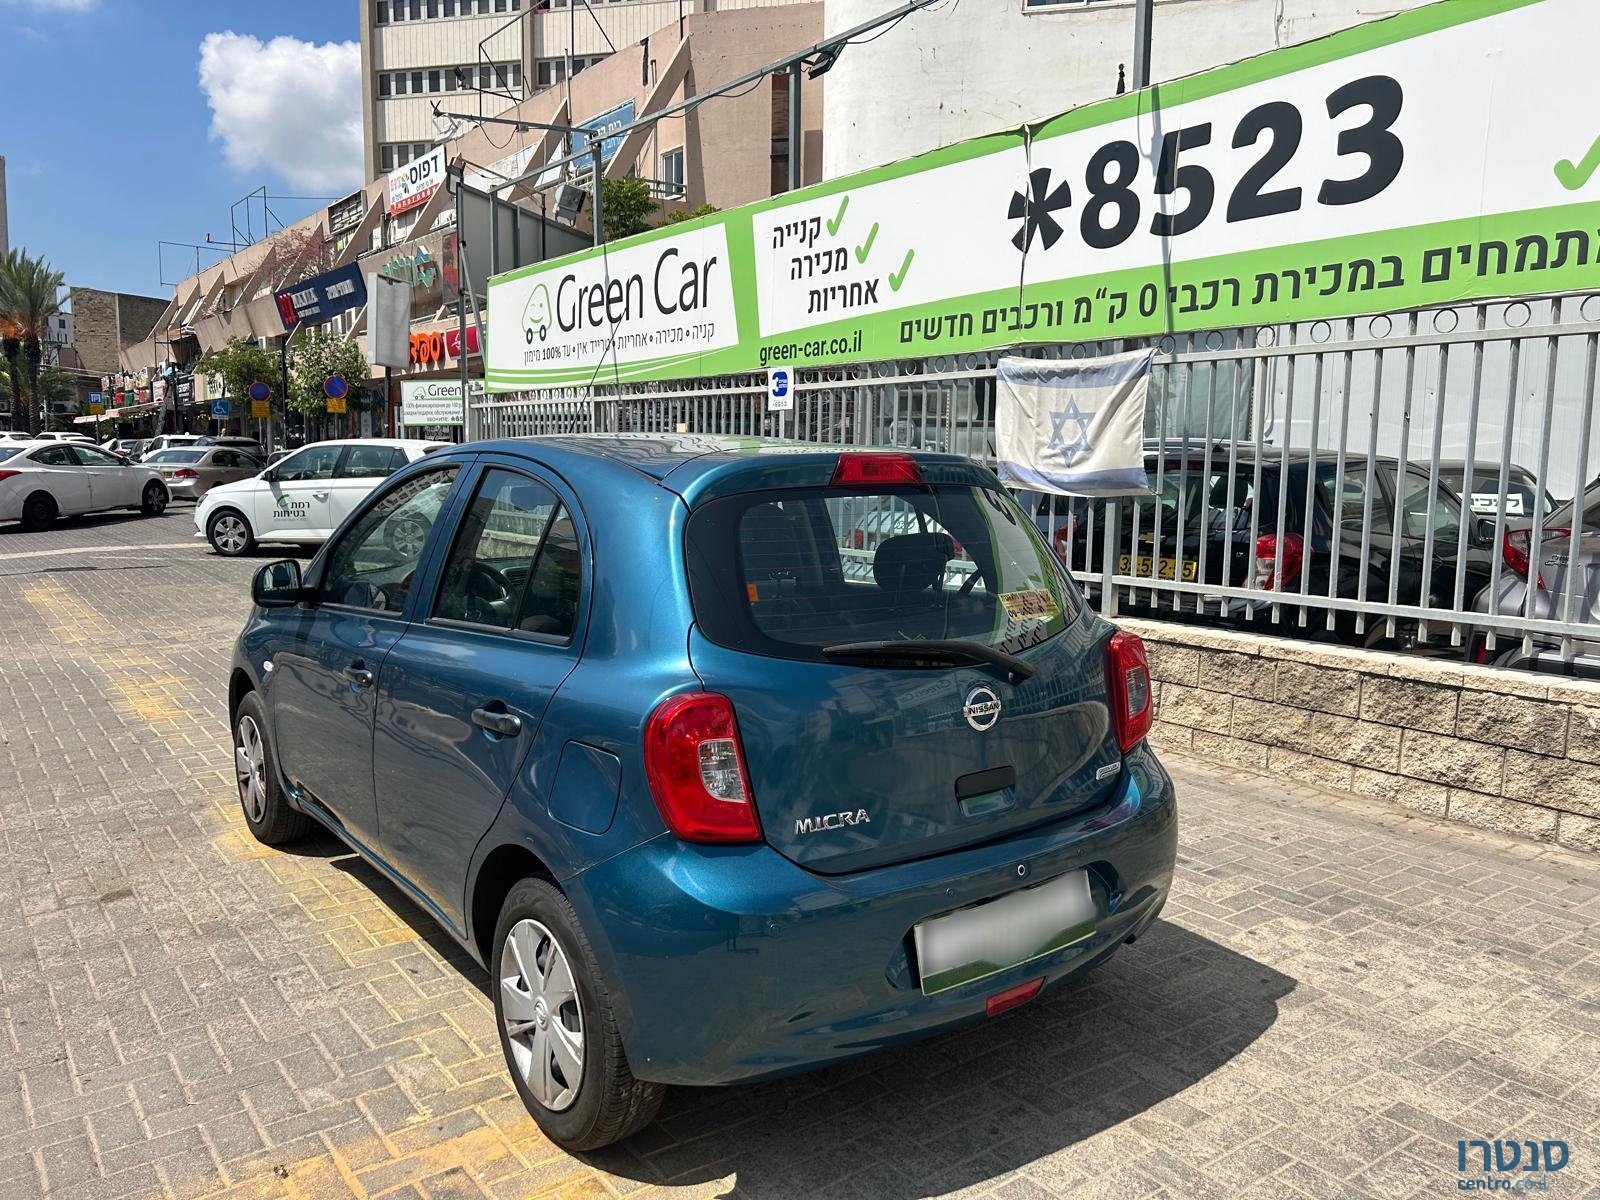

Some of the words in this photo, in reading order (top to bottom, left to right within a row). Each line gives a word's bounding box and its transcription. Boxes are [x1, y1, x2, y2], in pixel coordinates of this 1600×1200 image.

[409, 155, 438, 184] דפוס
[772, 216, 822, 249] קנייה
[790, 246, 848, 280] מכירה
[1421, 227, 1600, 284] תמחים
[556, 274, 643, 332] Green
[653, 248, 717, 314] Car
[1169, 275, 1240, 313] רכבי
[1251, 254, 1405, 305] במכירת
[807, 279, 879, 314] אחריות
[1139, 282, 1159, 318] 0
[900, 312, 974, 343] חדשים
[982, 300, 1064, 334] ורכבים
[617, 332, 648, 350] אחריות
[656, 326, 683, 344] מכירה
[692, 323, 715, 342] קניה
[760, 329, 862, 366] green-car.co.il
[524, 349, 540, 366] מימון
[542, 346, 561, 361] 100%
[562, 345, 571, 356] עד
[428, 384, 462, 397] Green
[291, 501, 310, 509] רמת
[969, 702, 1000, 714] NISSAN
[795, 808, 871, 835] MICRA
